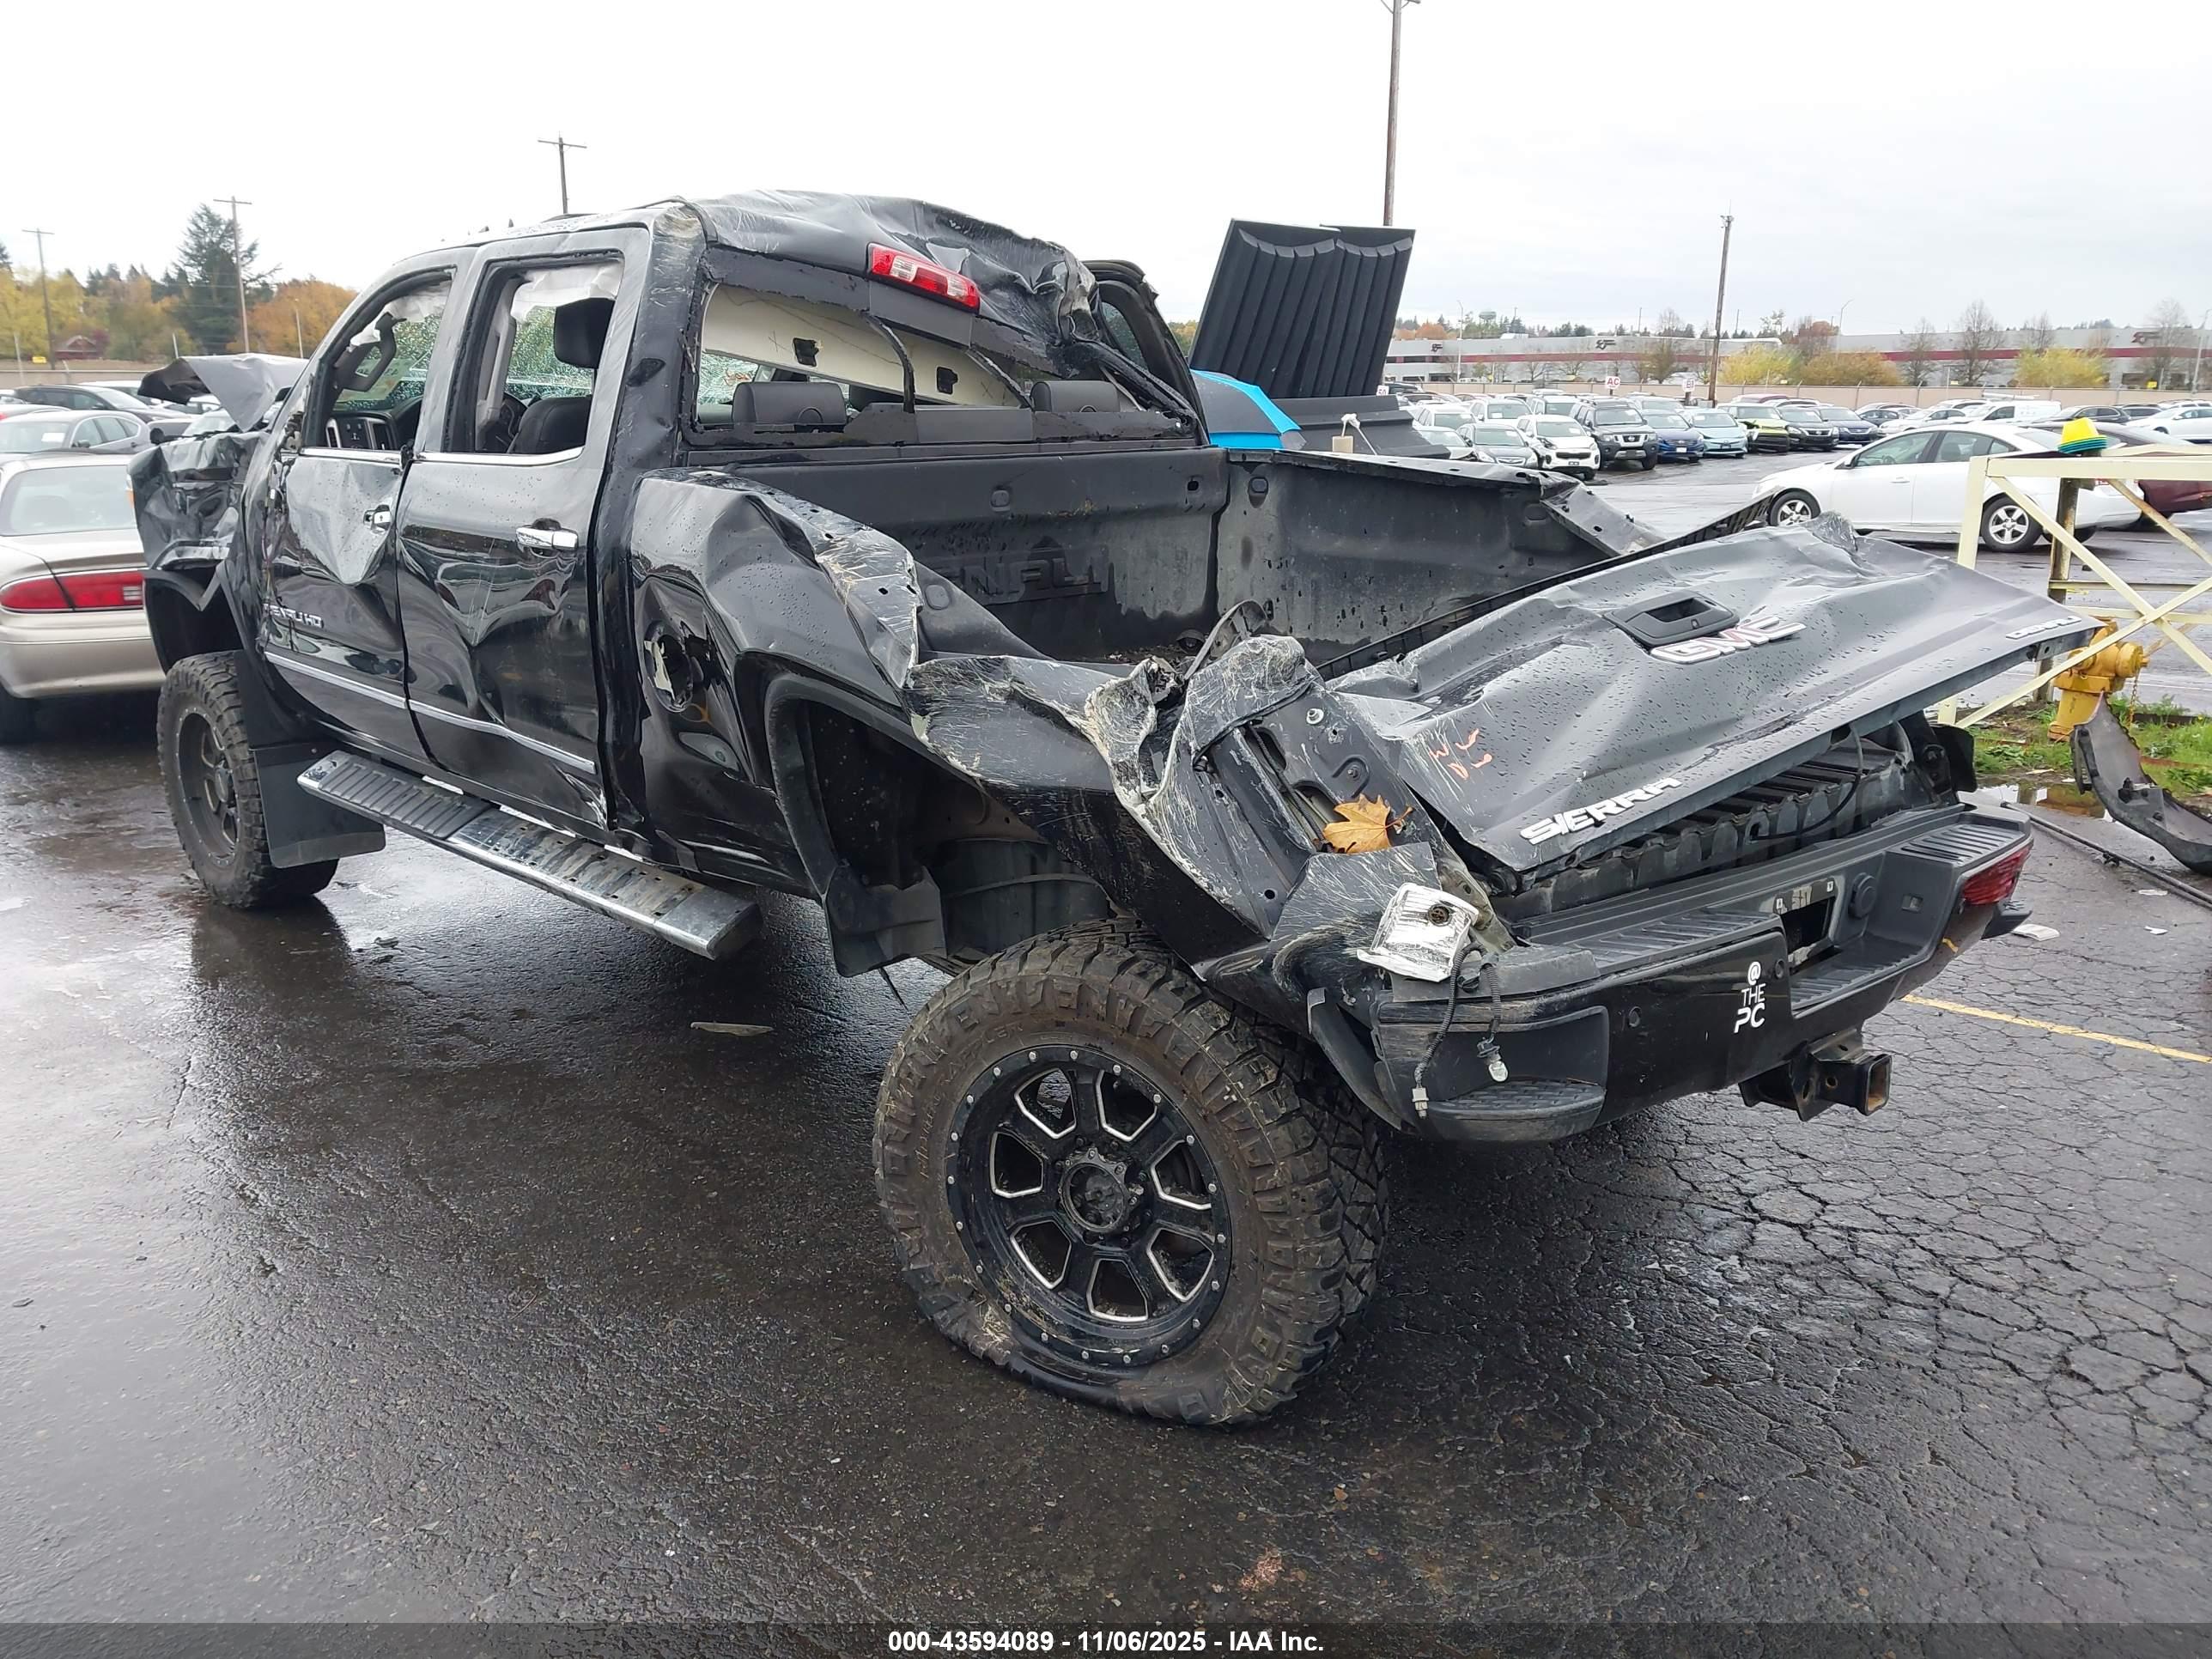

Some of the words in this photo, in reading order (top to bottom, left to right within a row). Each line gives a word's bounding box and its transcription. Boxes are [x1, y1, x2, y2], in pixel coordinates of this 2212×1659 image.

[1606, 377, 1620, 386] AC
[1650, 615, 1807, 665] GMC
[1519, 776, 1682, 845] SIERRA
[1747, 961, 1761, 986] @
[1741, 983, 1766, 1007] THE
[1734, 1002, 1765, 1034] PC
